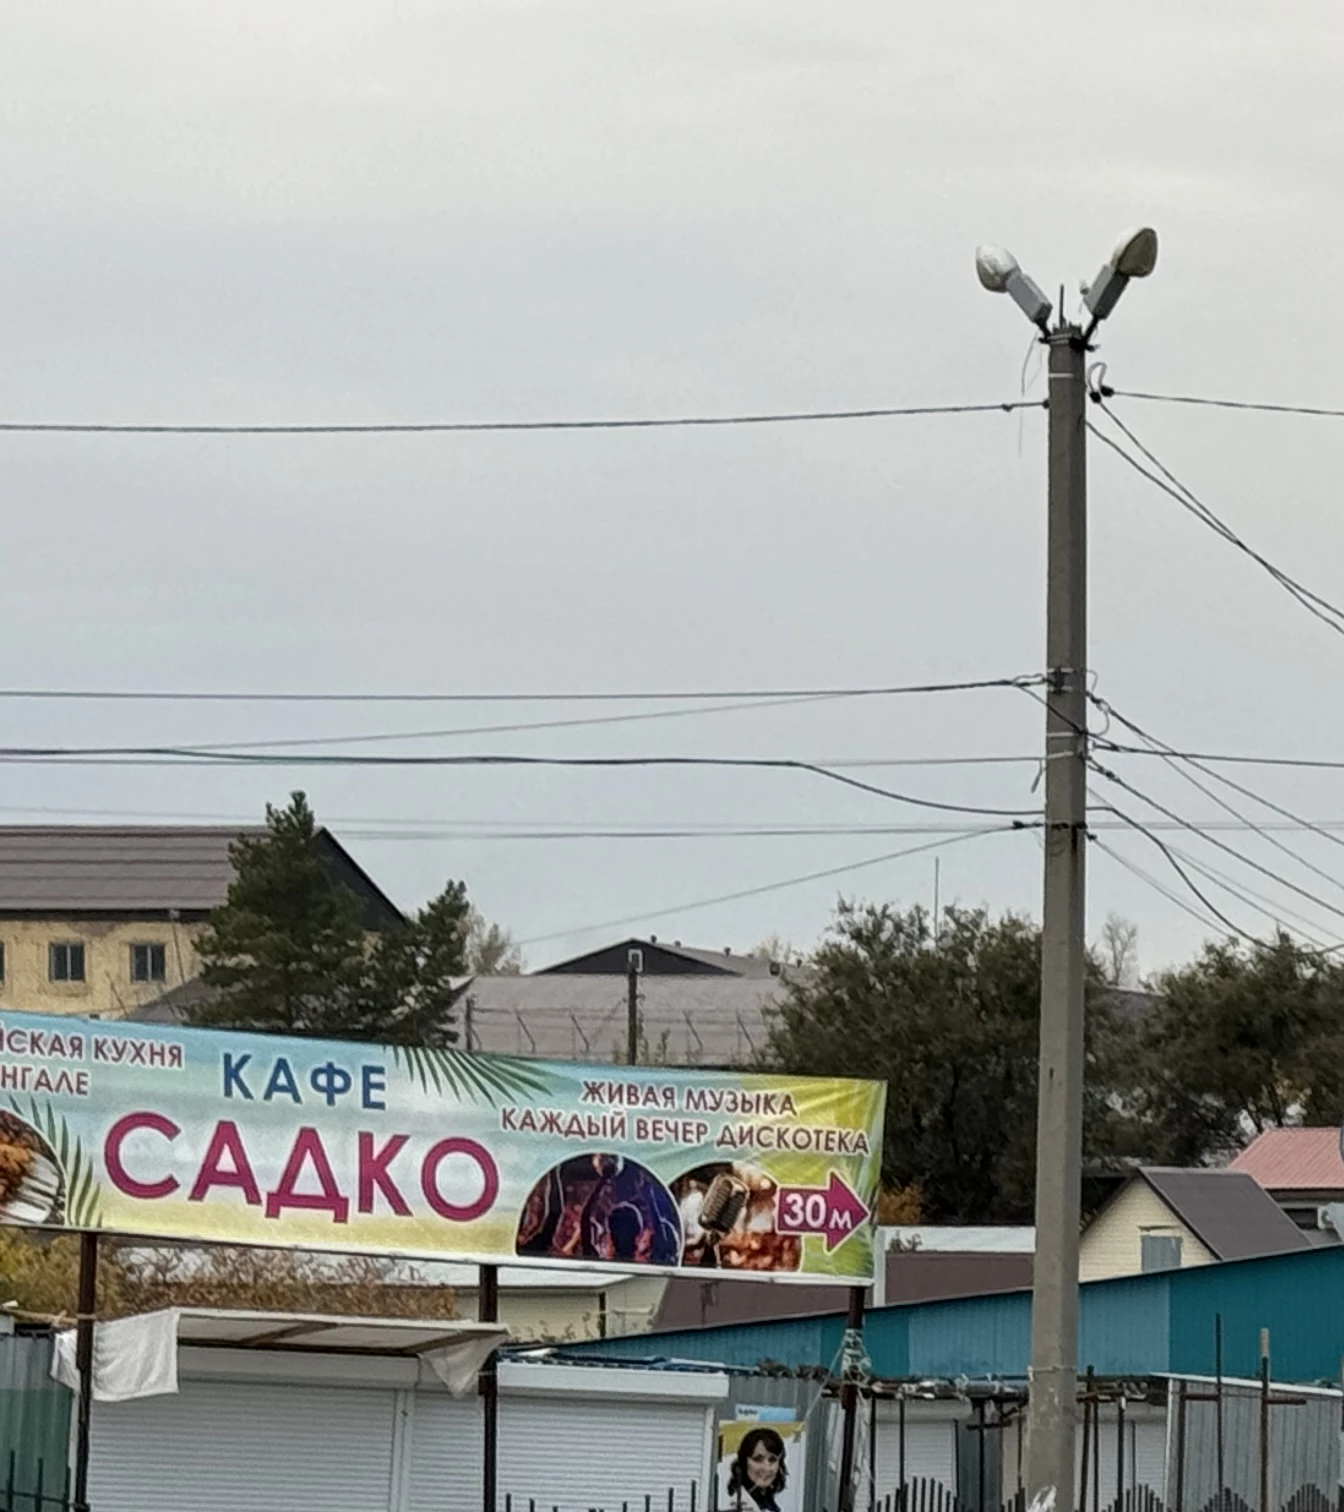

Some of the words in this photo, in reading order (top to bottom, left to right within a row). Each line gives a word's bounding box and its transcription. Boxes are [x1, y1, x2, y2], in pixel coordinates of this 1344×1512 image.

[0, 1024, 83, 1060] СКАЯ
[94, 1037, 183, 1069] КУХНЯ
[222, 1052, 387, 1110] КАФЕ
[582, 1080, 676, 1109] ЖИВАЯ
[686, 1089, 798, 1117] МУЗЫКА
[501, 1107, 627, 1139] КАЖДЫЙ
[636, 1120, 708, 1144] ВЕЧЕР
[716, 1125, 870, 1155] ДИСКОТЕКА
[104, 1111, 500, 1224] САДКО
